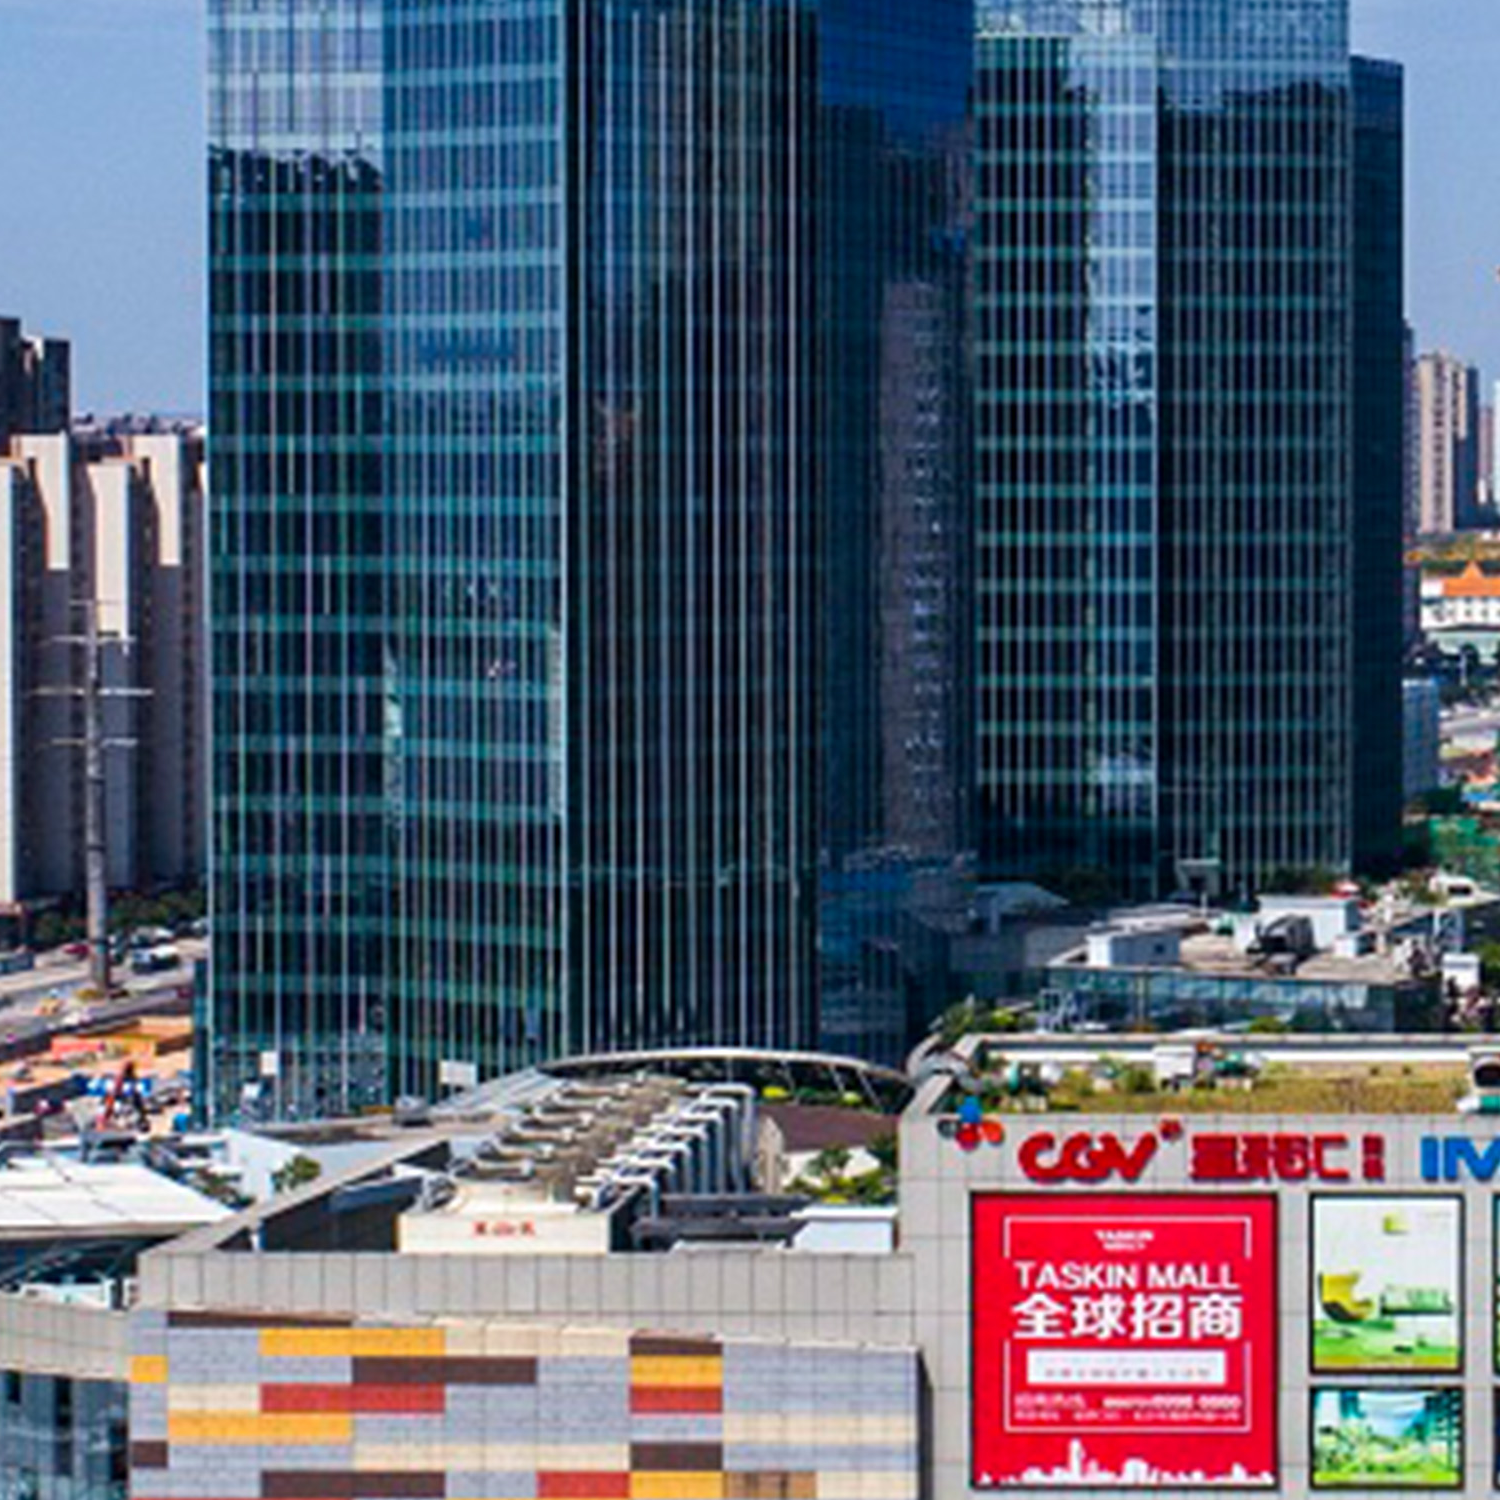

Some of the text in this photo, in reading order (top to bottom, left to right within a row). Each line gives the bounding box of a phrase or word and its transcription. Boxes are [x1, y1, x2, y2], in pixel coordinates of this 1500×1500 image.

[1017, 1131, 1158, 1183] CGV
[1013, 1260, 1240, 1289] TASKIN MALL
[1011, 1292, 1243, 1340] 全球招商
